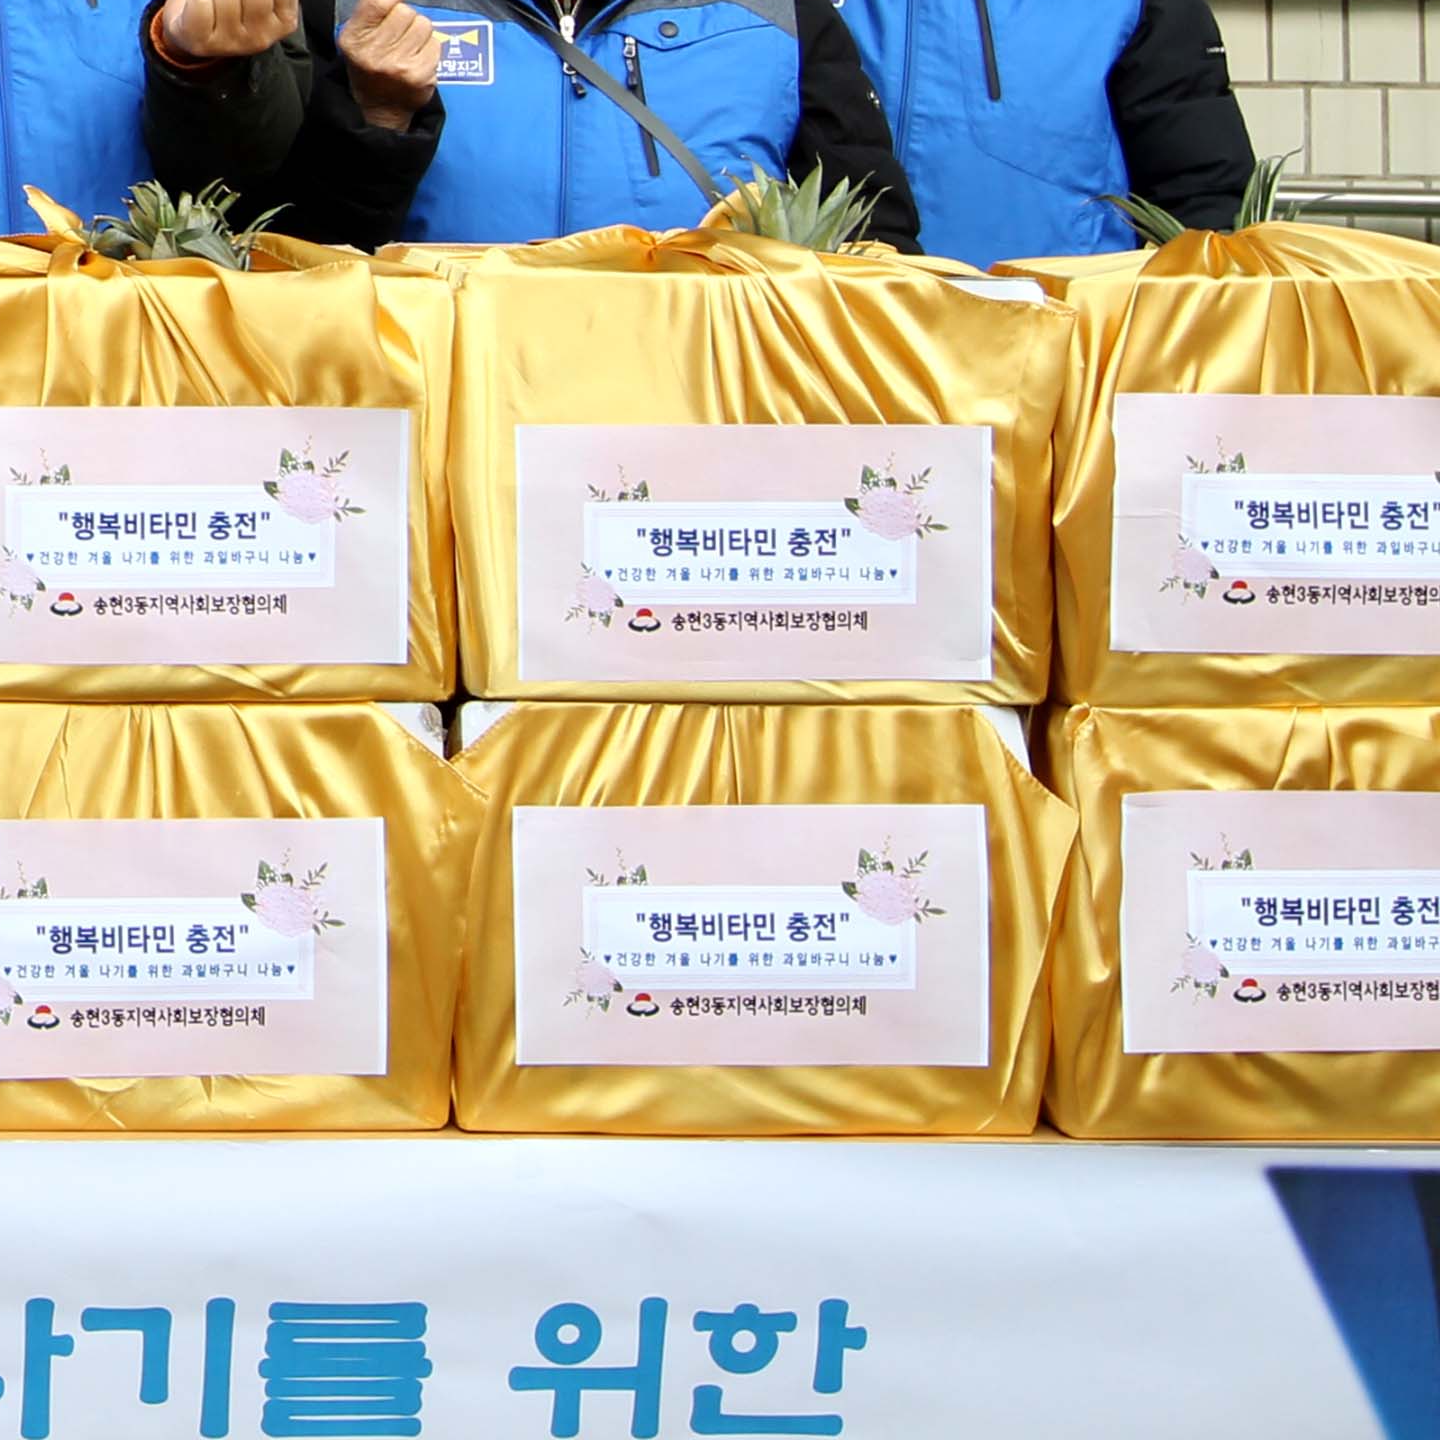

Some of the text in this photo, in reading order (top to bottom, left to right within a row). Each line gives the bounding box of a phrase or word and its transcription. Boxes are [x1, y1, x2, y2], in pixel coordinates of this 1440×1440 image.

[59, 511, 271, 541] "행복비타민 충전"
[1234, 500, 1369, 530] "행복비타민
[637, 528, 851, 558] "행복비타민 충전"
[1214, 540, 1252, 554] 건강한
[1262, 540, 1287, 554] 겨울
[1296, 540, 1332, 555] 나기를
[1343, 540, 1367, 555] 위한
[39, 551, 303, 565] 건강한 겨울 나기를 위한 과일바구니 나눔
[618, 567, 885, 582] 건강한 겨울 나기를 위한 과일바구니 나눔
[93, 594, 287, 616] 송현3동지역사회보장협의체
[672, 611, 867, 632] 송현3동지역사회보장협의체
[1241, 896, 1380, 927] "행복비타민
[36, 924, 248, 954] "행복비타민 충전"
[636, 912, 850, 942] "행복비타민 충전"
[70, 1006, 265, 1028] 송현3동지역사회보장협의체
[670, 995, 867, 1016] 송현3동지역사회보장협의체
[509, 1297, 868, 1439] 위한
